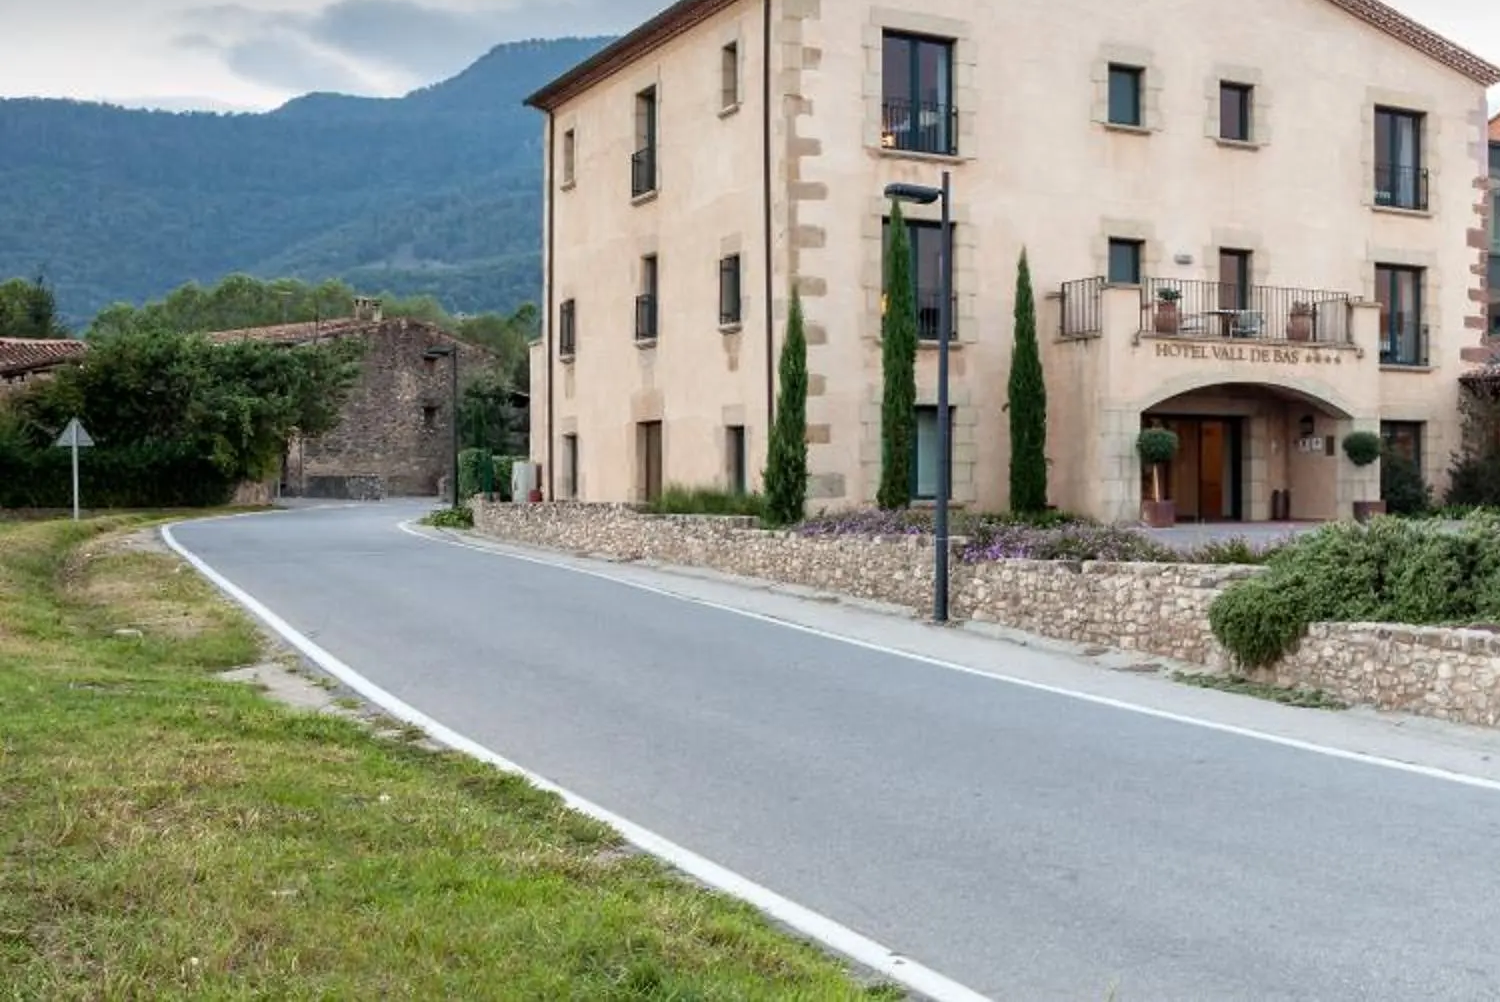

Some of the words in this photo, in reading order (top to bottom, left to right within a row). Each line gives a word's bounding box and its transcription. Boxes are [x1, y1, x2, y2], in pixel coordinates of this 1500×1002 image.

[1155, 343, 1208, 359] HOTEL
[1211, 346, 1247, 361] VALL
[1250, 349, 1271, 363] DE
[1273, 350, 1300, 364] BAS
